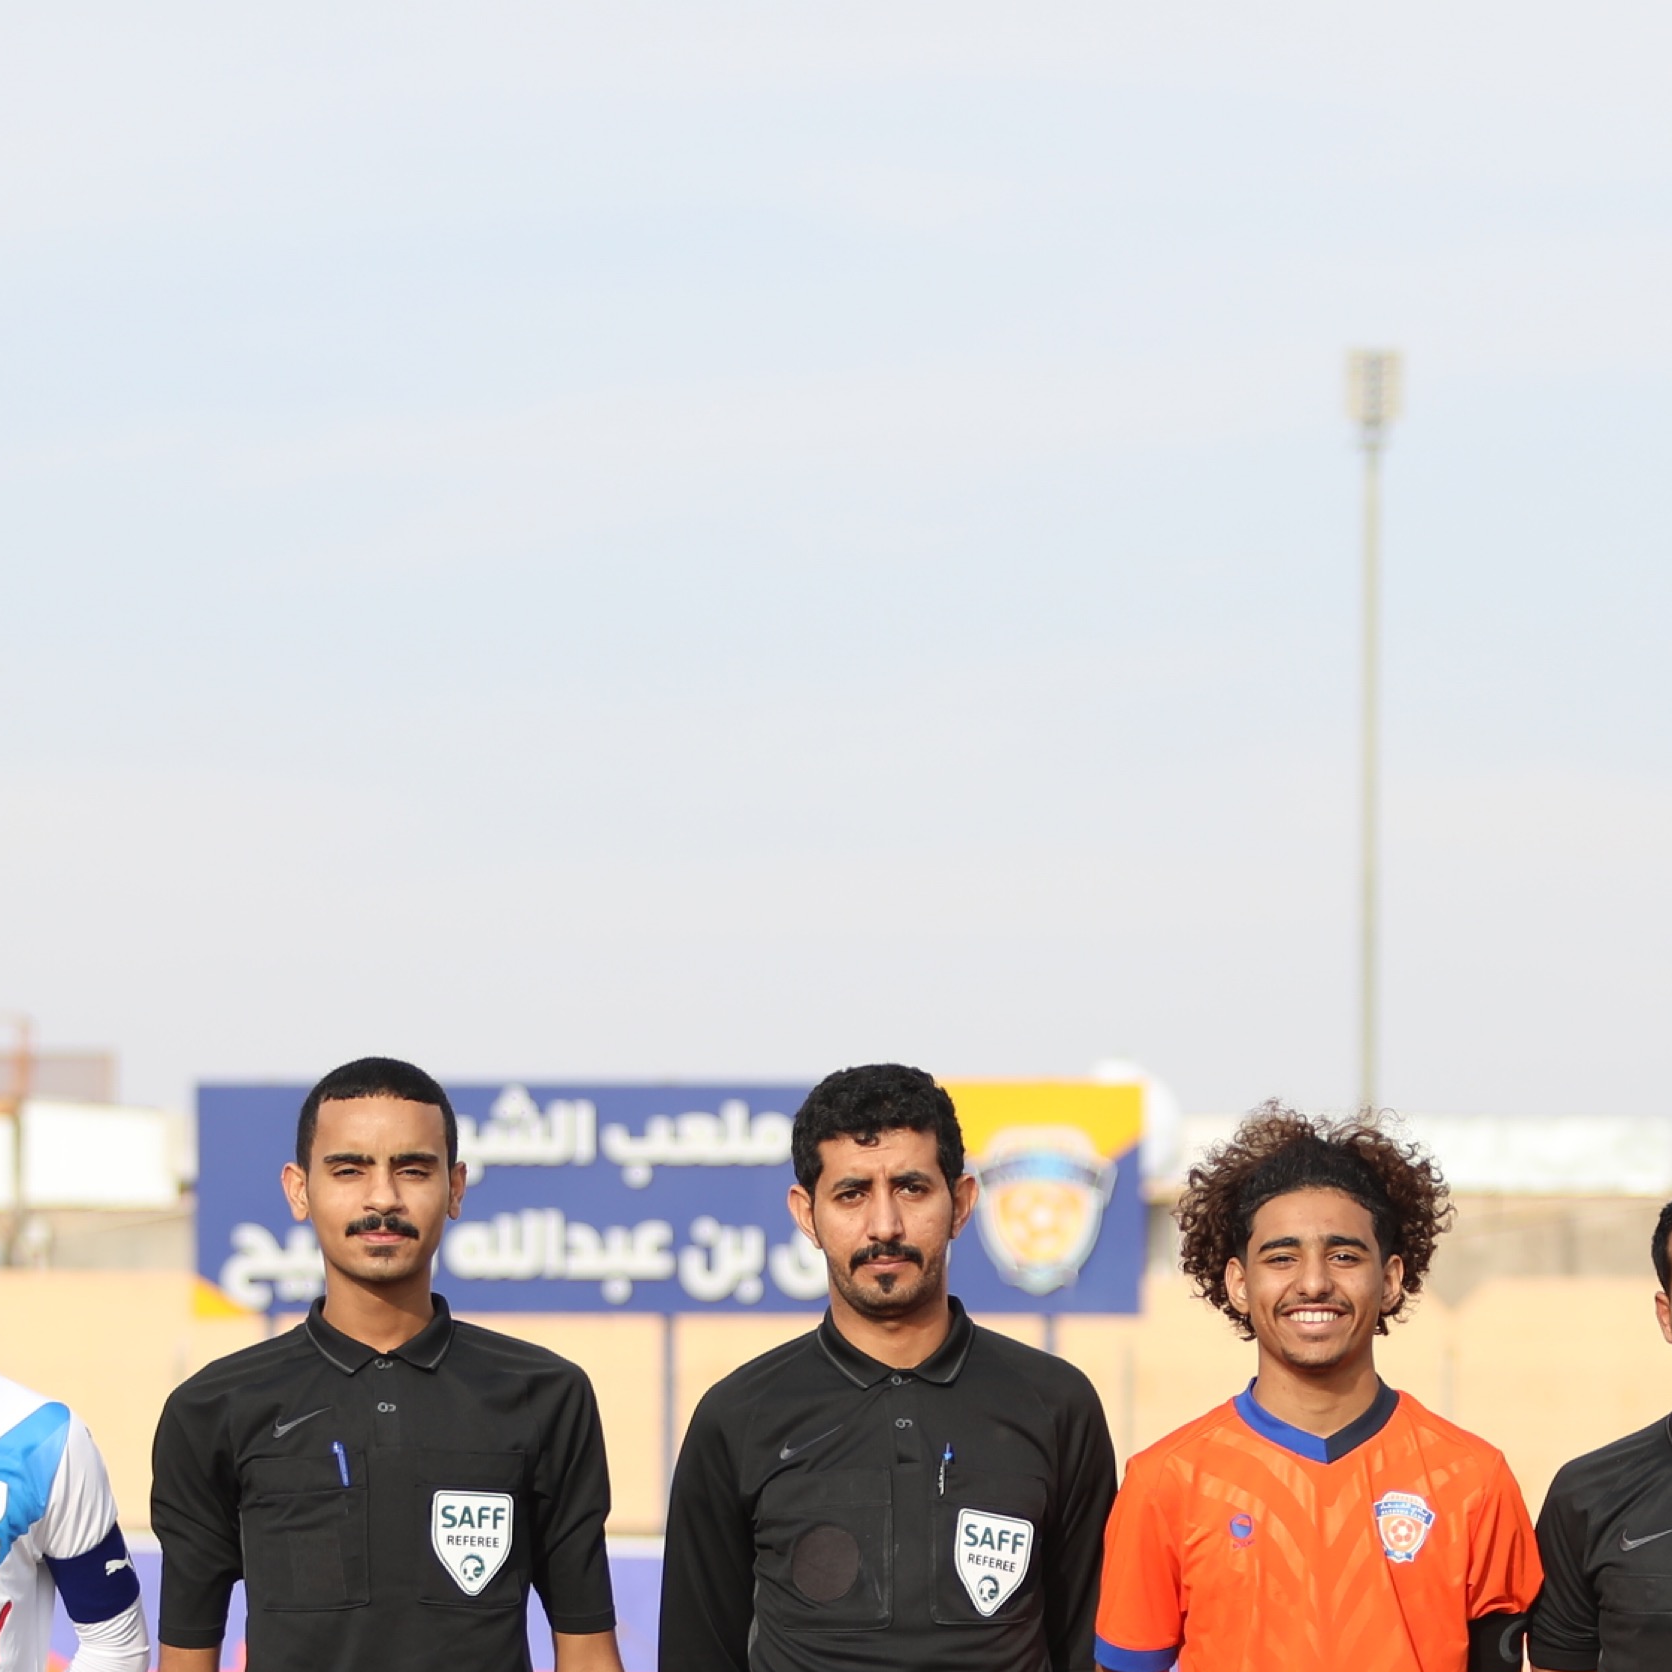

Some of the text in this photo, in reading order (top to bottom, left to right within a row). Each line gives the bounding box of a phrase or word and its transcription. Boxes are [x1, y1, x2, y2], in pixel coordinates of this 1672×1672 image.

[602, 1099, 793, 1181] ملعب
[444, 1207, 676, 1305] عبدالله
[678, 1215, 767, 1305] بن
[441, 1504, 506, 1530] SAFF
[445, 1535, 499, 1548] REFEREE
[963, 1523, 1026, 1555] SAFF
[968, 1553, 1016, 1573] REFEREE
